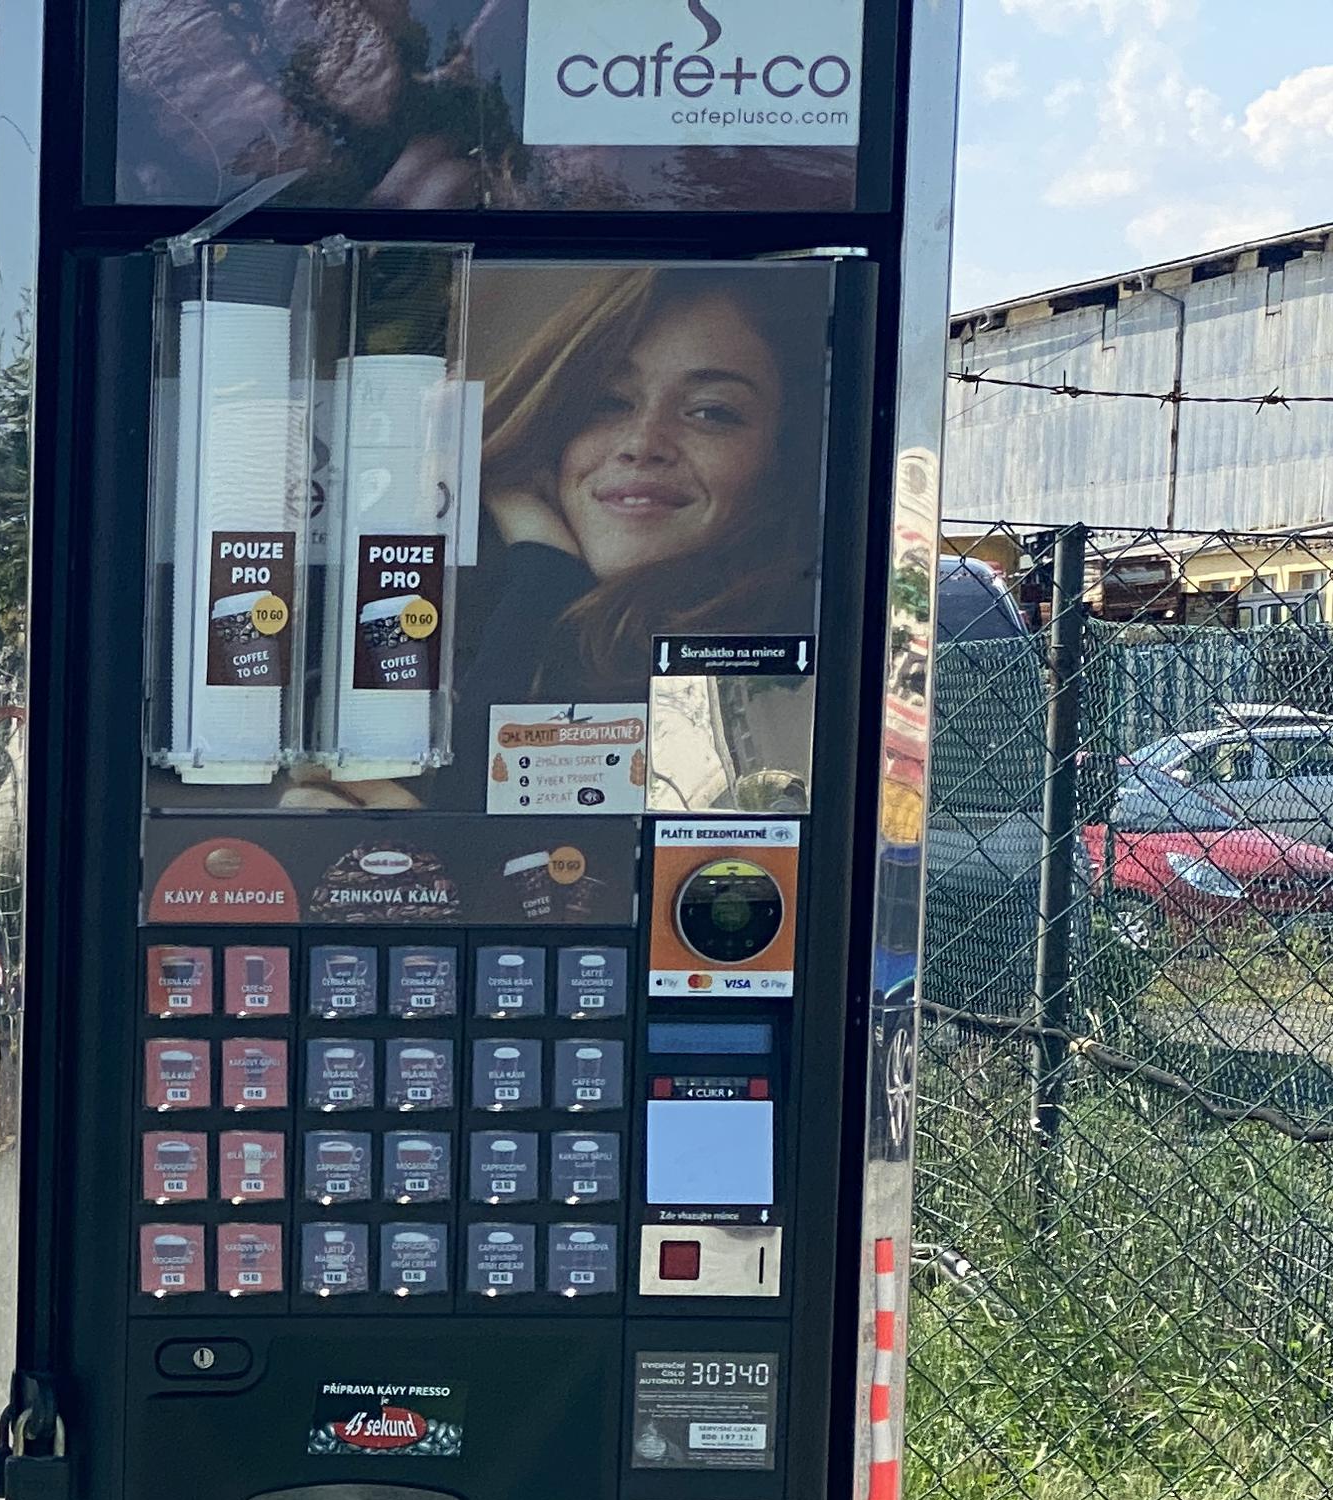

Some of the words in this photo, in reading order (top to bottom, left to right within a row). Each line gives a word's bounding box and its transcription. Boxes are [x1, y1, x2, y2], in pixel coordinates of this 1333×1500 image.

[557, 42, 851, 98] café+co
[671, 108, 849, 128] cafeplusco.com
[220, 542, 284, 559] POUZE
[369, 546, 434, 564] POUZE
[231, 567, 271, 584] PRO
[380, 571, 421, 588] PRO
[255, 609, 270, 621] TO
[270, 609, 284, 621] GO
[404, 613, 419, 625] TO
[419, 613, 433, 625] GO
[232, 650, 270, 667] COFFEE
[380, 654, 420, 671] COFFEE
[237, 667, 251, 679] TO
[252, 665, 269, 677] GO
[384, 671, 399, 683] TO
[400, 668, 417, 681] GO
[164, 887, 206, 905] KÁVY
[209, 890, 220, 905] &
[224, 887, 286, 905] NÁPOJE
[330, 888, 404, 904] ZRNKOVÁ
[408, 888, 450, 904] KÁVA
[724, 978, 752, 989] VISA
[695, 1088, 725, 1098] CUKR
[691, 1363, 770, 1386] 30340
[323, 1382, 375, 1396] PŘÍPRAVA
[377, 1384, 407, 1396] KÁVY
[408, 1386, 451, 1397] PRESSO
[364, 1412, 418, 1438] sekund
